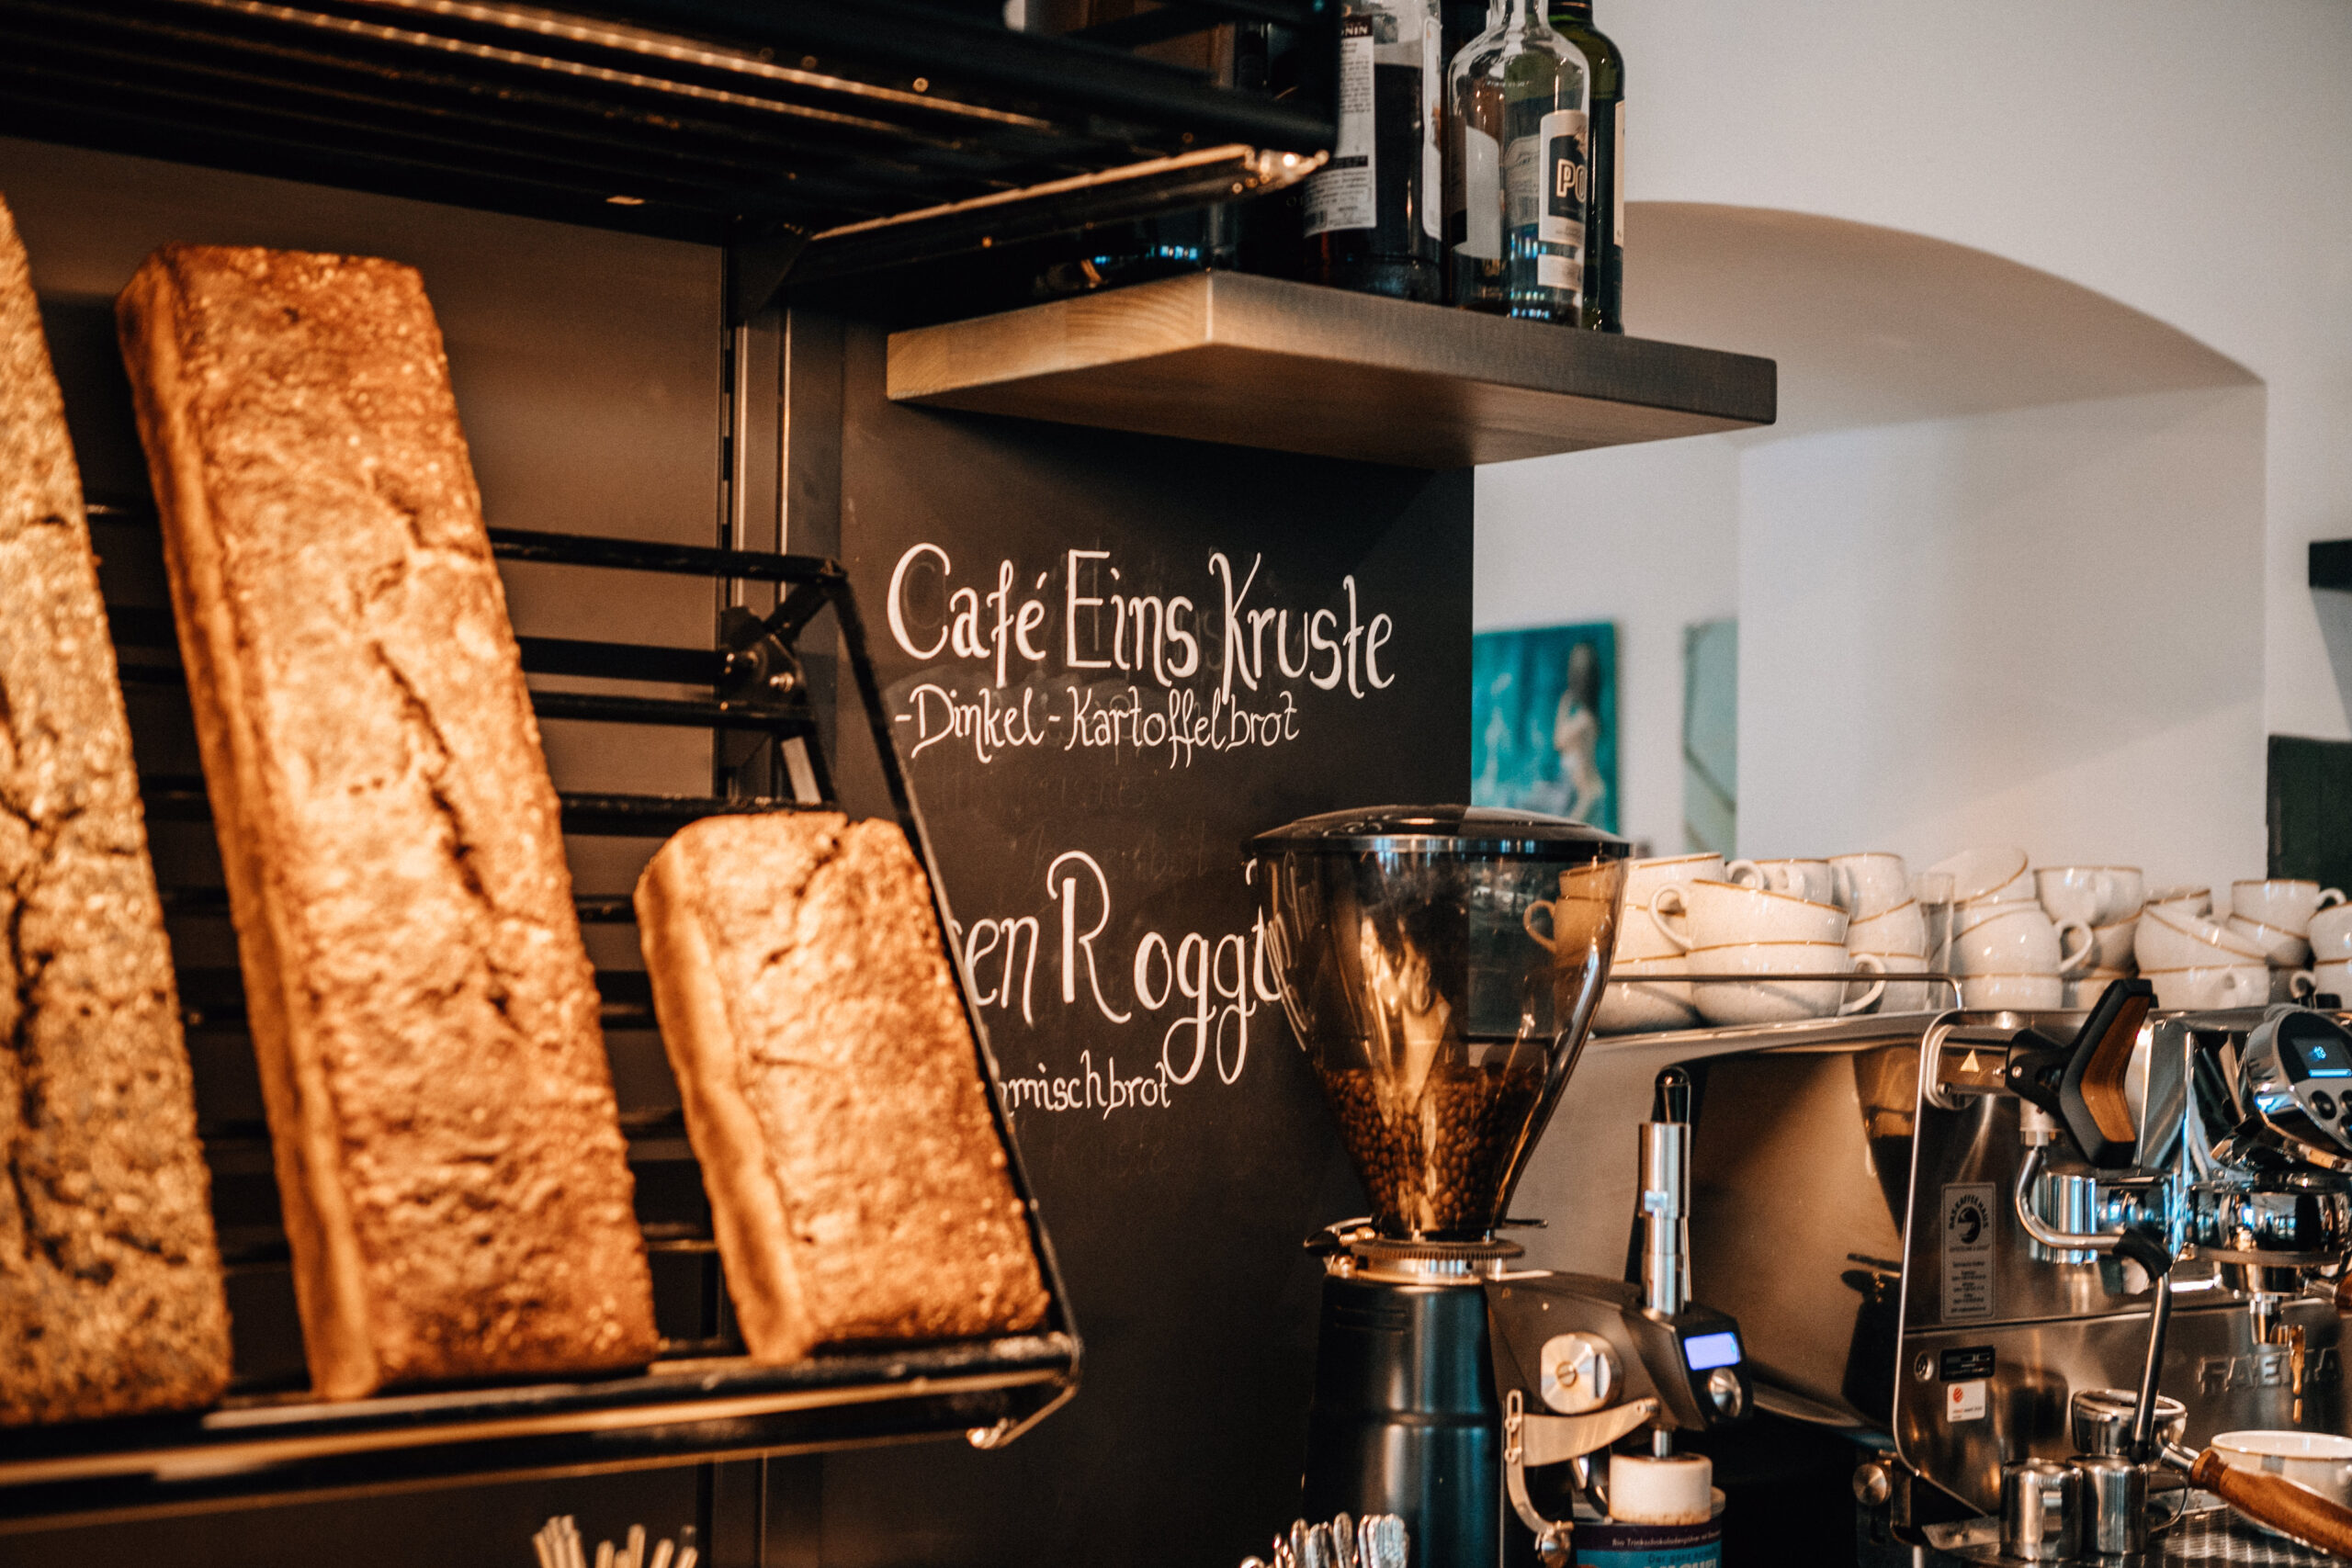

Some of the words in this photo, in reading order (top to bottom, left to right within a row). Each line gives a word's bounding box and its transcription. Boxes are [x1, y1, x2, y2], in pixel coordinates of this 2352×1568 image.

[887, 542, 1046, 689] Café
[1066, 548, 1199, 688] Eins
[1208, 551, 1396, 705] Kruste
